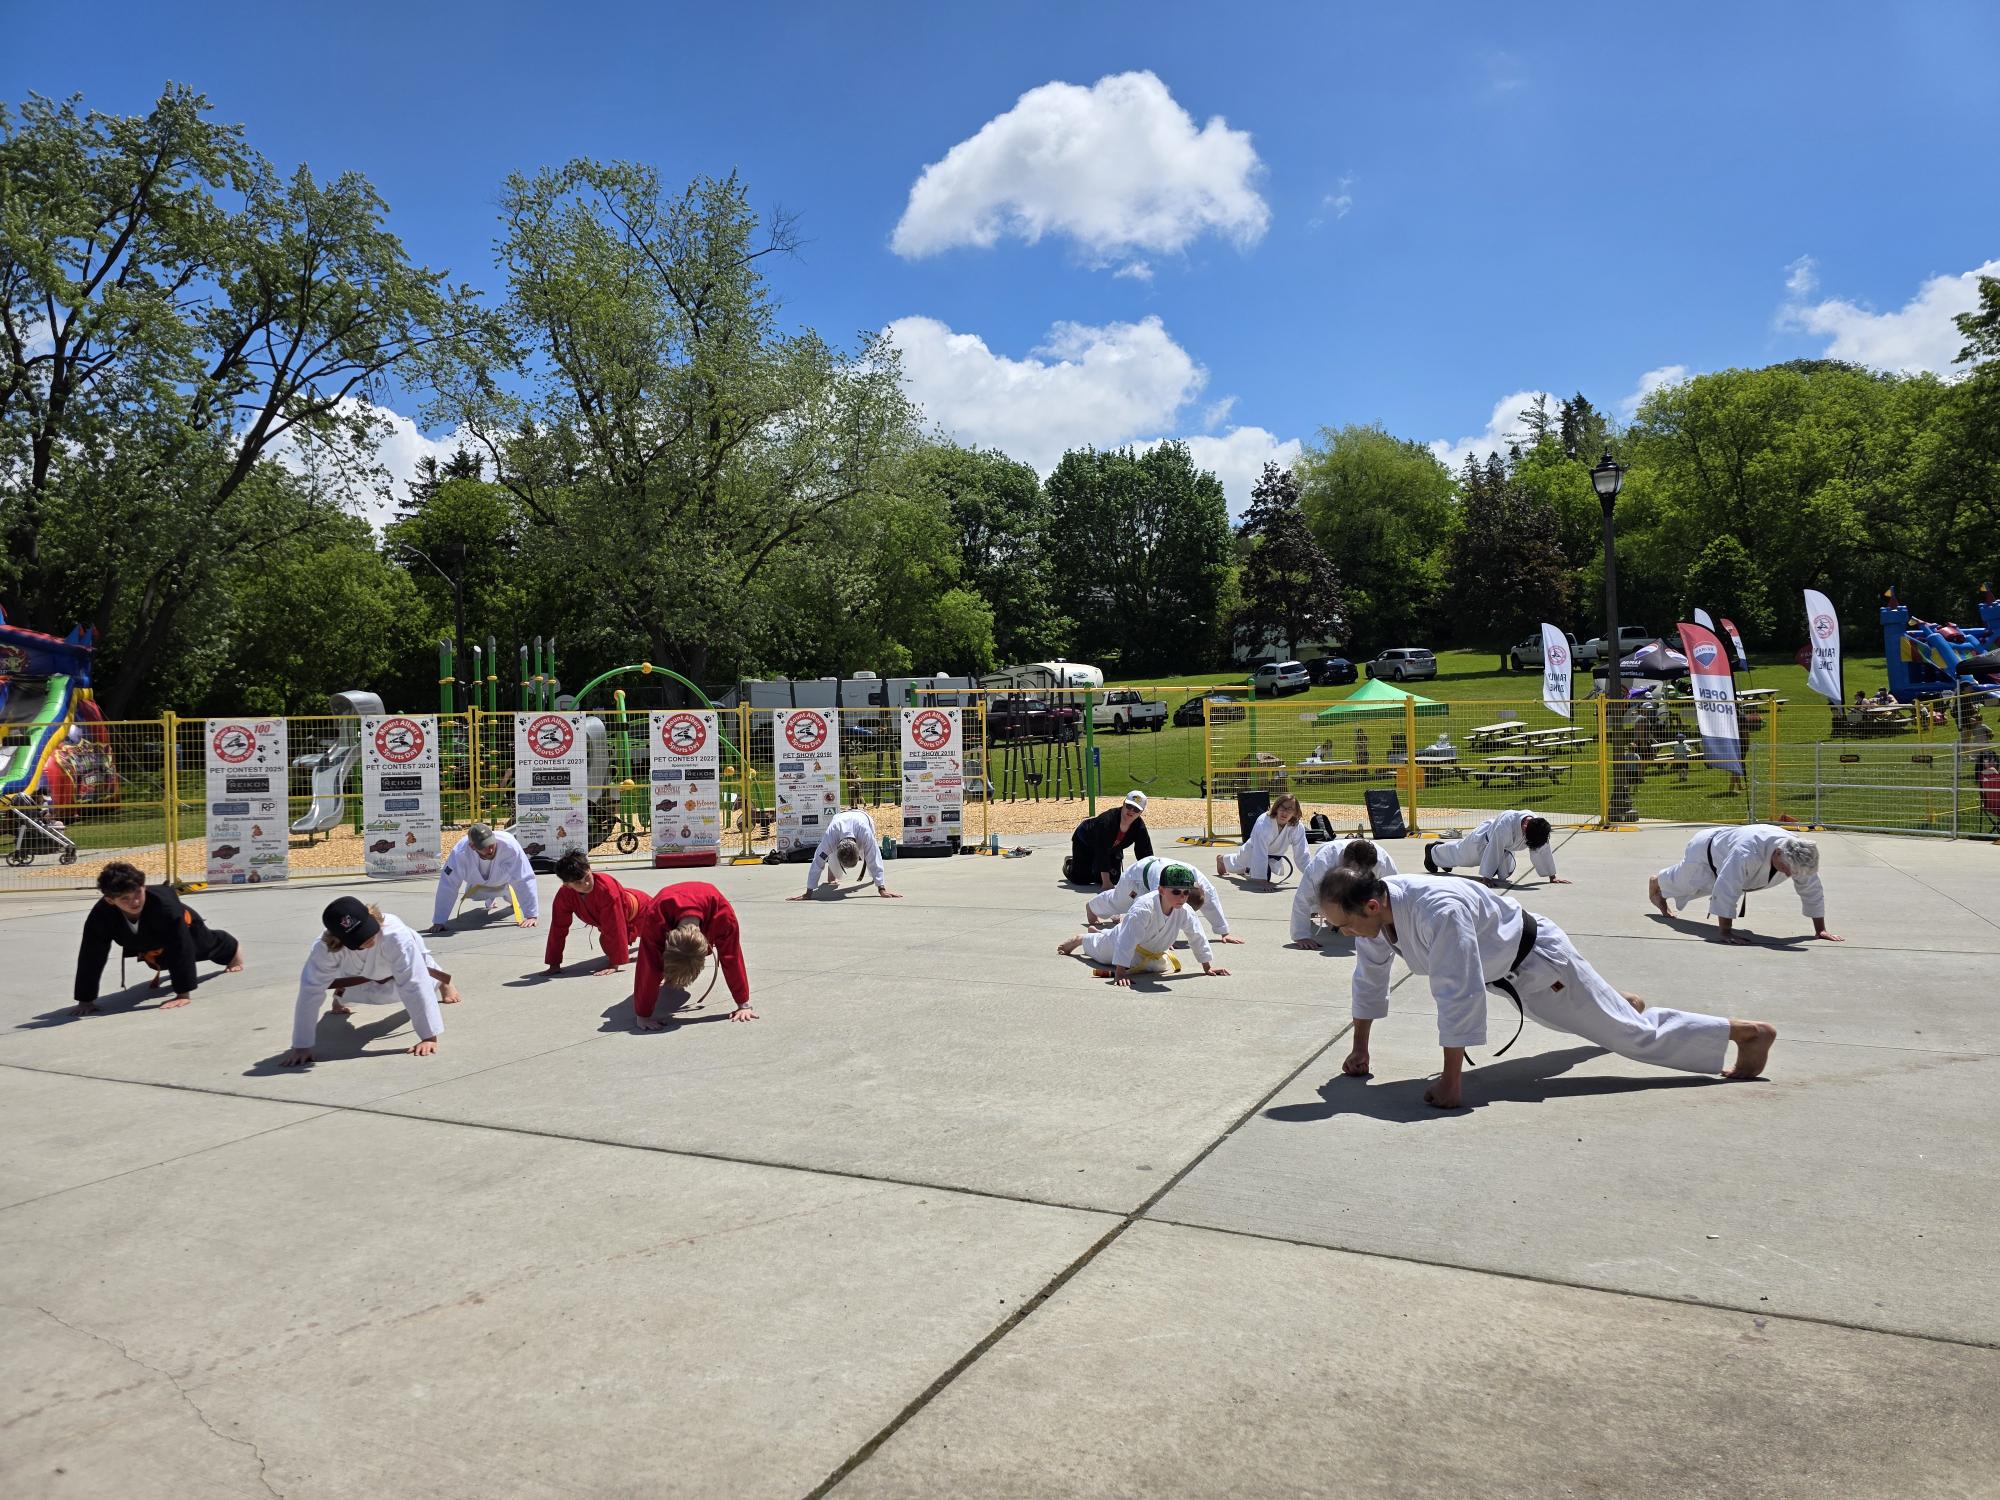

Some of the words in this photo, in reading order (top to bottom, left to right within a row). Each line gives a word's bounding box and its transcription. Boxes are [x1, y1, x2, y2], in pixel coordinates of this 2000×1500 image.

[530, 717, 550, 732] Mount
[551, 717, 569, 732] Albert
[666, 716, 683, 729] Mount
[684, 716, 702, 729] Albert
[789, 713, 806, 726] Mount
[806, 713, 822, 726] Albert
[914, 712, 931, 725] Mount
[932, 712, 948, 725] Albert
[378, 720, 399, 736] Mount
[400, 720, 420, 735] Albert
[668, 742, 688, 752] Sports
[688, 742, 700, 751] Day
[792, 739, 810, 748] Sports
[810, 738, 821, 747] Day
[918, 738, 934, 747] Sports
[382, 748, 405, 760] Sports
[405, 748, 418, 758] Day
[535, 744, 554, 756] Sports
[555, 744, 567, 755] Day
